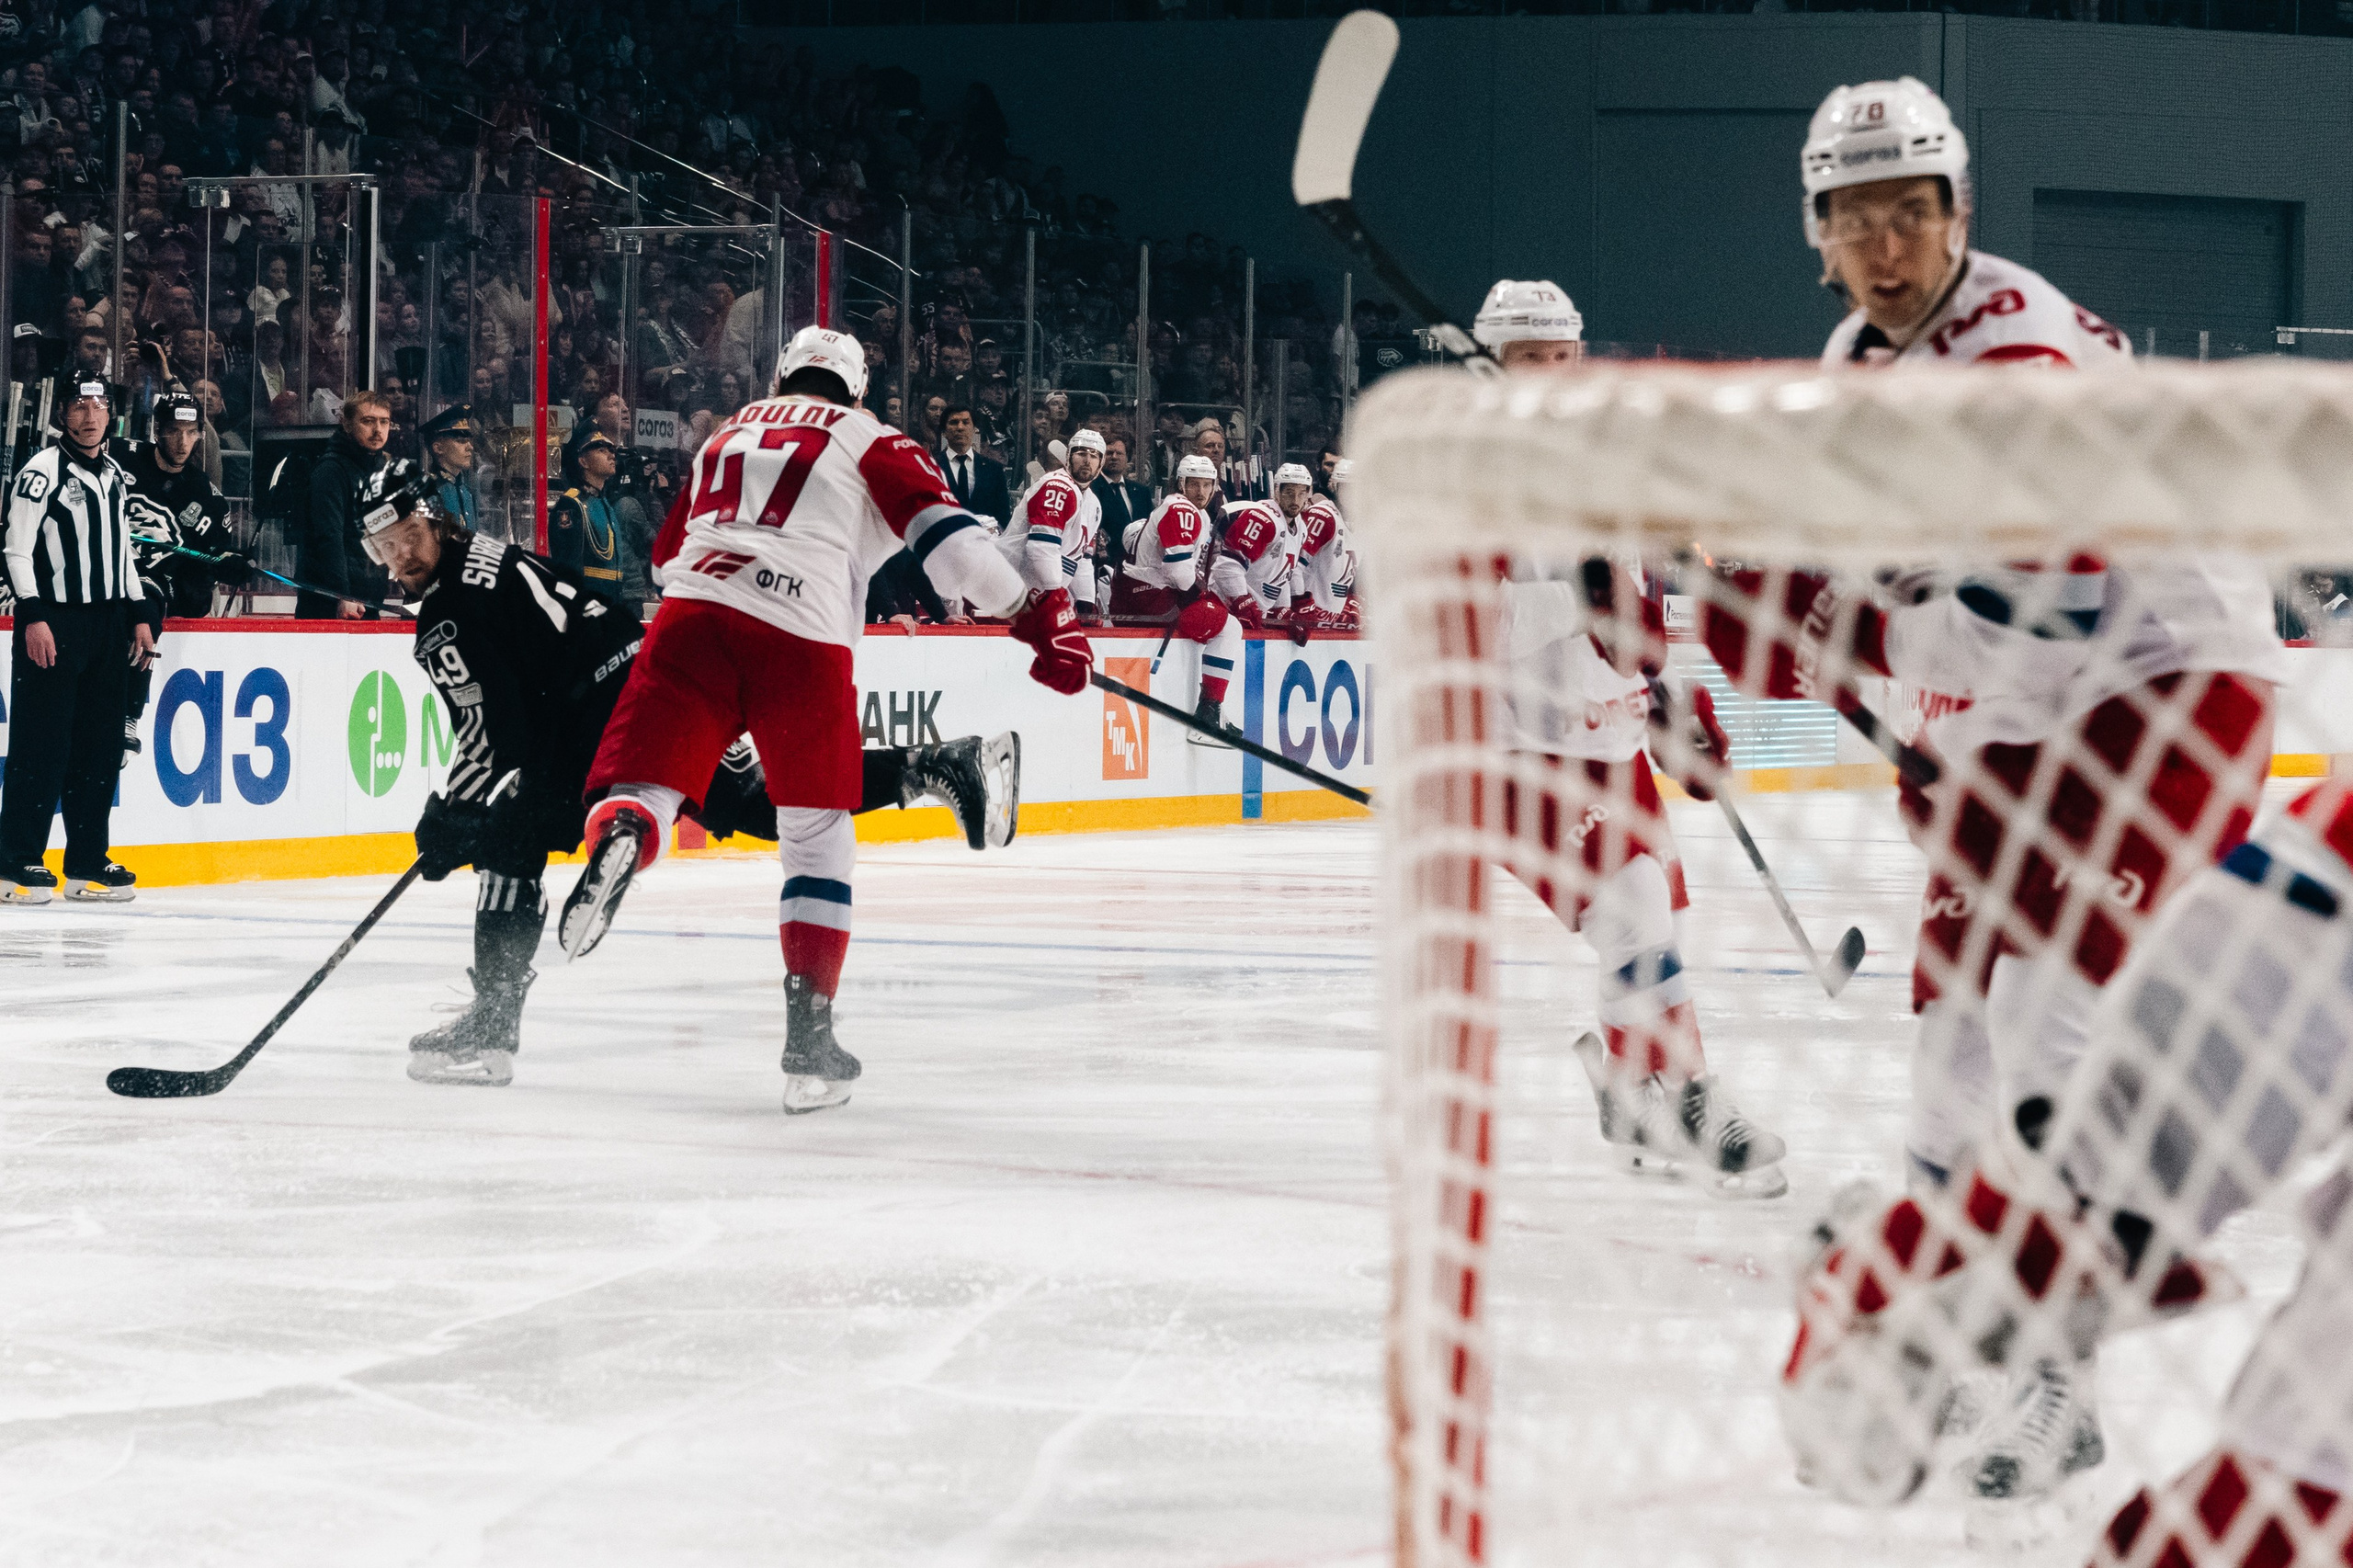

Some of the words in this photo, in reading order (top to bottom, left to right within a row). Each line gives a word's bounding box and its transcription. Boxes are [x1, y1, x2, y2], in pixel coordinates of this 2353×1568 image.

[637, 417, 674, 438] согаз
[21, 472, 47, 499] 78
[689, 426, 832, 529] 47
[1043, 489, 1068, 512] 26
[367, 507, 395, 528] согаз
[1176, 511, 1195, 531] 10
[1244, 518, 1264, 540] 16
[1306, 516, 1325, 537] 70
[461, 531, 507, 590] SHAB
[756, 568, 804, 598] ФГК
[426, 644, 471, 687] 49
[860, 690, 943, 748] АНК
